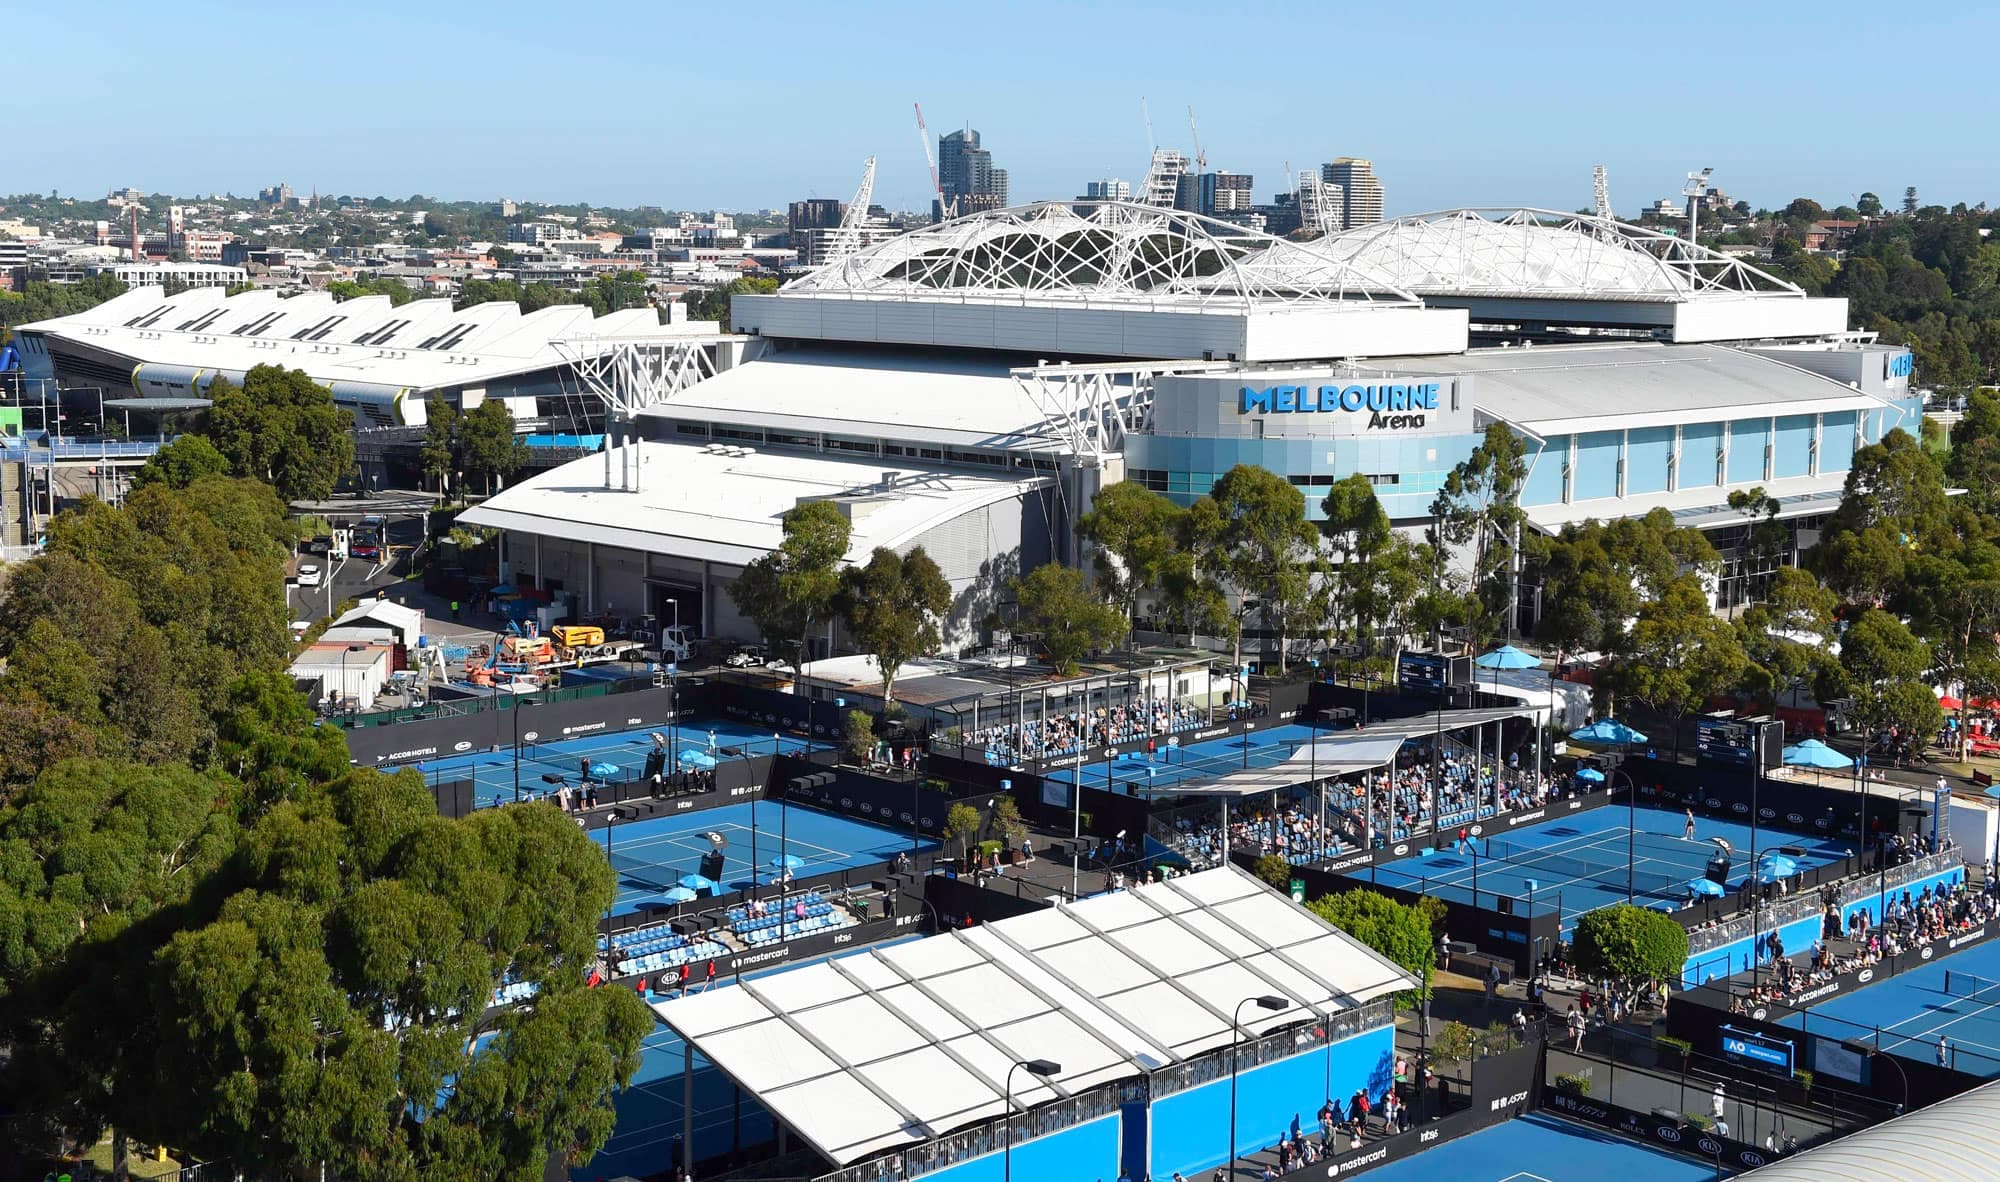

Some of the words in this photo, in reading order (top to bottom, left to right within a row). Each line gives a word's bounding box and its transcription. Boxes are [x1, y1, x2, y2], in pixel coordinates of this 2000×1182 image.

[1241, 383, 1440, 413] MELBOURNE
[1367, 412, 1426, 431] Arena
[743, 946, 789, 965] mastercard
[1729, 1039, 1746, 1052] AO
[1339, 1146, 1387, 1172] mastercard
